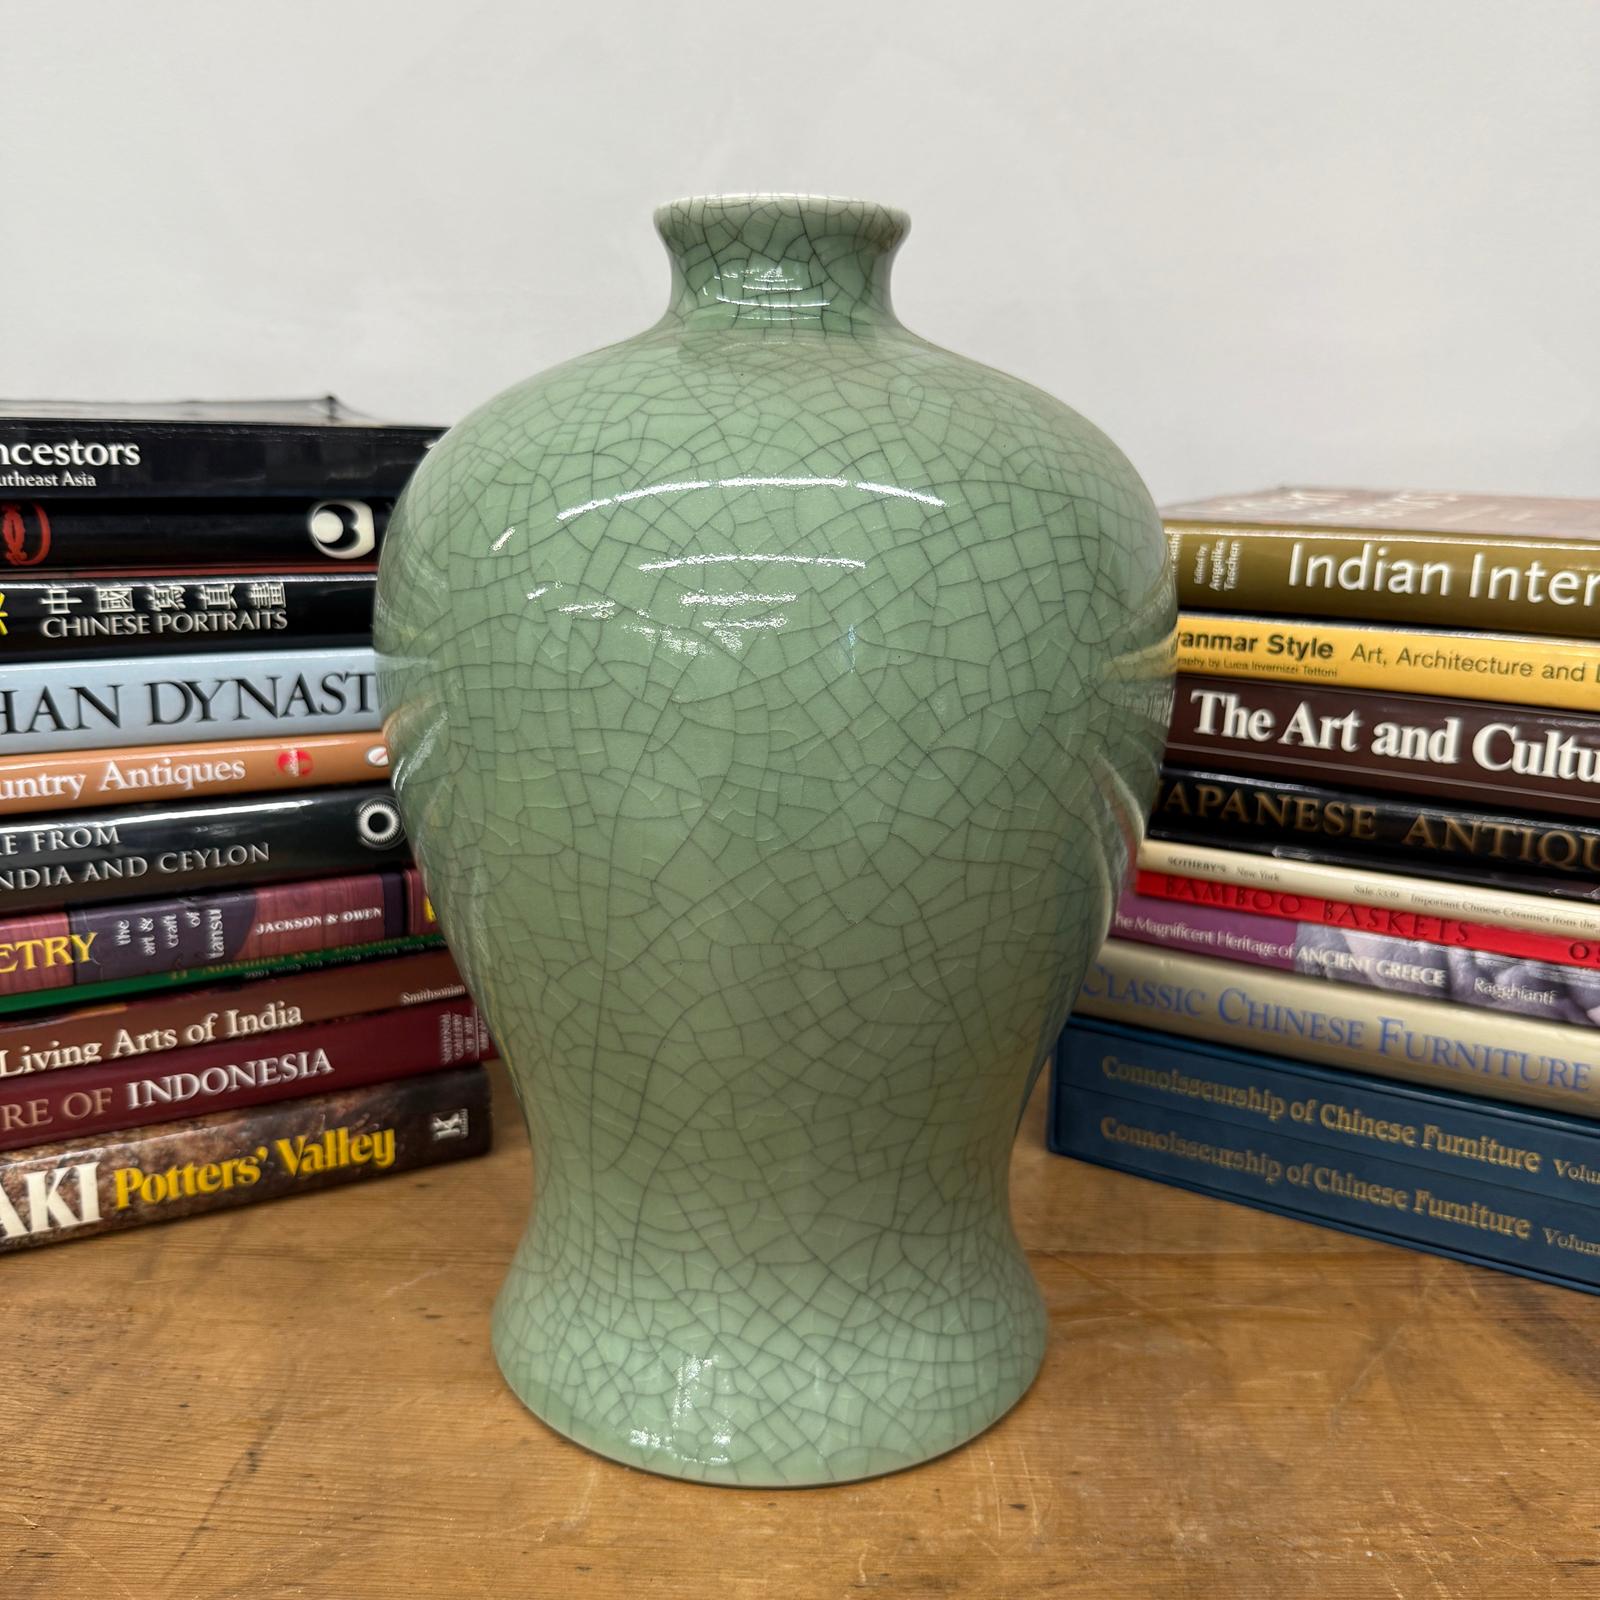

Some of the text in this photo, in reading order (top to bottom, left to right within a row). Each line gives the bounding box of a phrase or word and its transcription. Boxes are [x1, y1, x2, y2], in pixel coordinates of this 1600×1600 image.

[62, 471, 97, 487] Asia
[1288, 541, 1600, 607] Indian Inter
[40, 608, 288, 639] CHINESE PORTRAITS
[1208, 657, 1220, 669] by
[1266, 633, 1334, 660] Style
[1350, 643, 1387, 667] Art,
[1396, 647, 1533, 678] Architecture
[1541, 662, 1585, 682] and
[1190, 689, 1276, 743] The
[1278, 699, 1360, 753] Art
[1371, 716, 1463, 765] and
[99, 757, 246, 792] Antiques
[32, 825, 121, 852] FROM
[83, 857, 148, 883] AND
[158, 842, 271, 875] CEYLON
[1166, 876, 1300, 914] BAMBOO
[1323, 895, 1469, 943] BASKETS
[1168, 856, 1227, 873] SOTHEBY'S
[1260, 870, 1280, 882] York
[1411, 894, 1461, 911] Important
[1463, 901, 1502, 916] Chinese
[1504, 904, 1550, 923] Ceramics
[162, 913, 179, 948] craft
[185, 911, 201, 928] of
[255, 907, 382, 935] JACKSON & OWEN
[1134, 914, 1213, 946] Magnificent
[1218, 931, 1278, 958] Heritage
[1278, 943, 1296, 960] of
[1297, 945, 1371, 973] ANCIENT
[1376, 958, 1447, 988] GREECE
[400, 984, 466, 1005] Smithsonian
[0, 999, 304, 1078] Living Arts of India
[1216, 986, 1365, 1049] CHINESE
[1377, 1016, 1592, 1092] FURNITURE
[62, 1087, 113, 1121] OF
[125, 1047, 336, 1110] INDONESIA
[1101, 1055, 1285, 1122] Connoisseurship
[1290, 1099, 1318, 1124] of
[1318, 1104, 1417, 1148] Chinese
[1423, 1124, 1542, 1173] Furniture
[111, 1145, 269, 1210] Potters'
[275, 1126, 397, 1177] Valley
[1100, 1117, 1282, 1184] Connoisseurship
[1286, 1162, 1314, 1186] of
[1313, 1166, 1408, 1211] Chinese
[1414, 1188, 1531, 1239] Furniture
